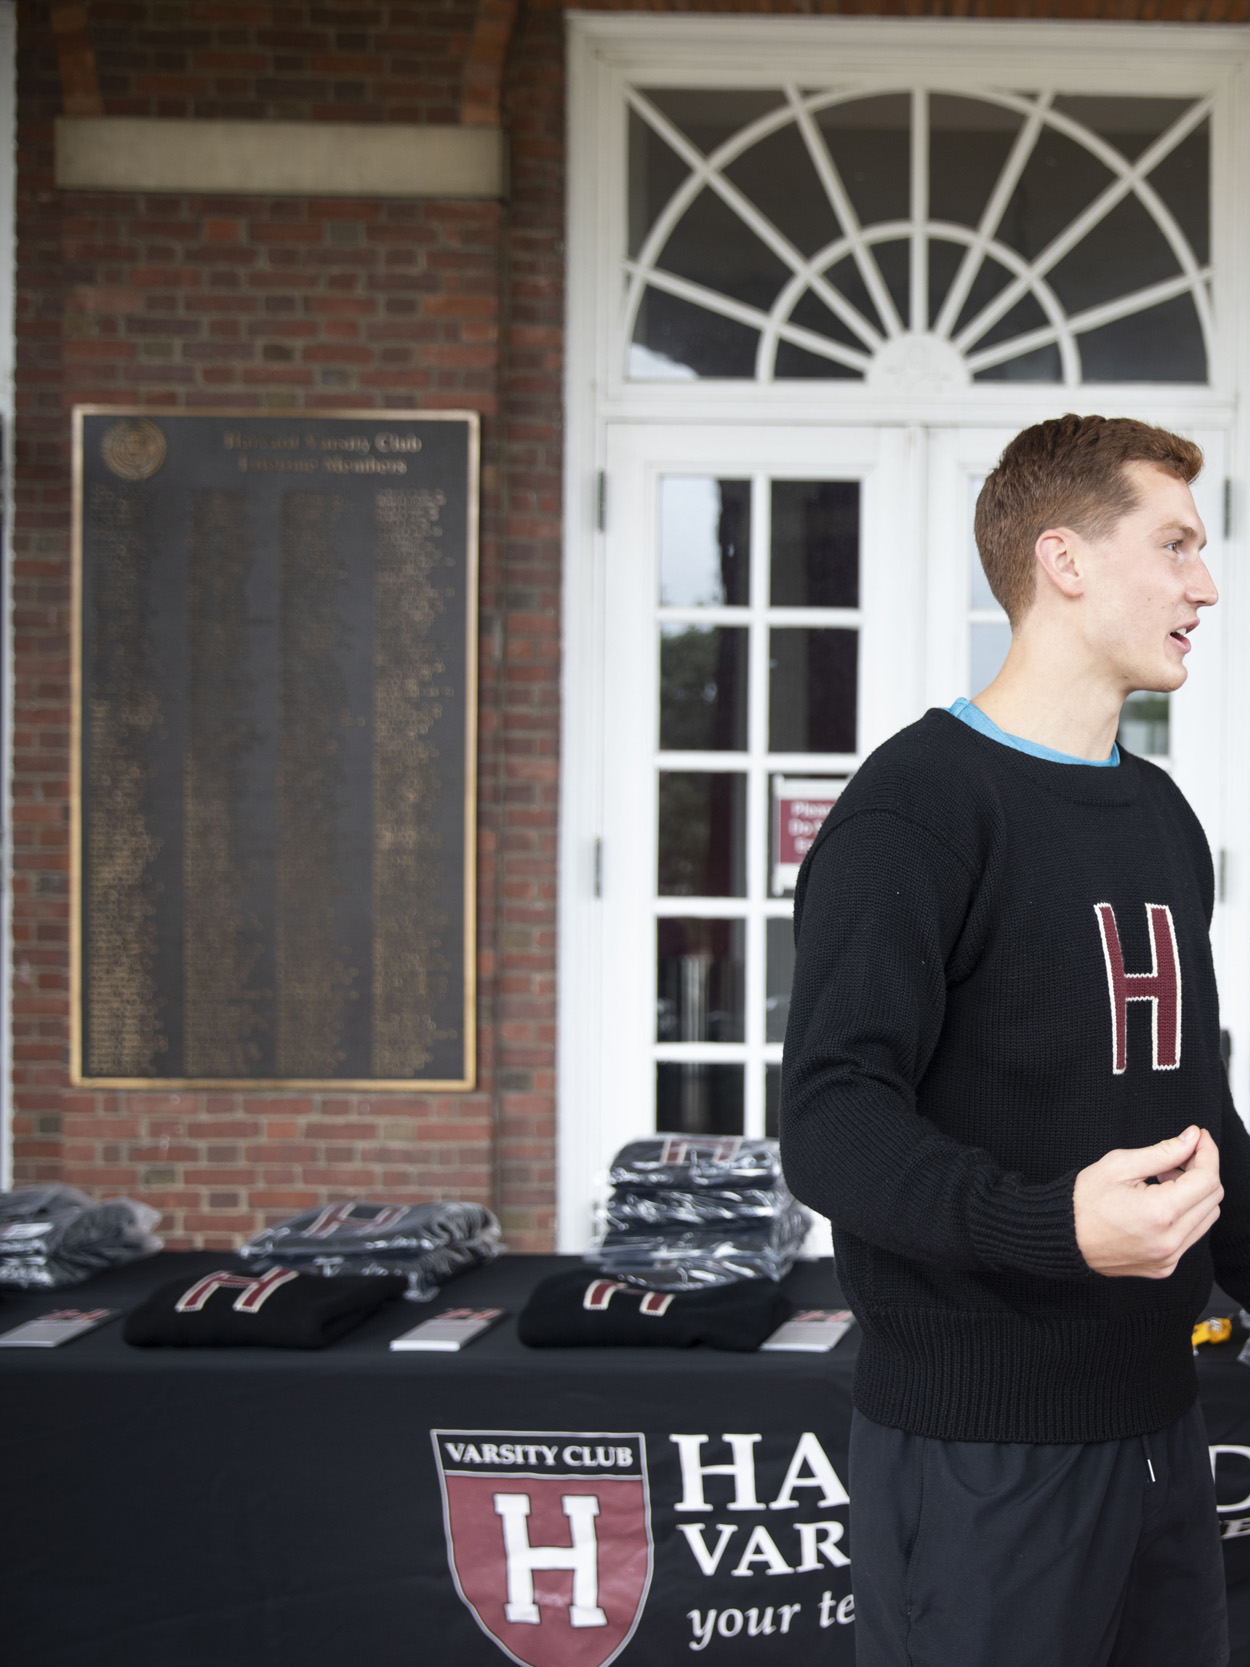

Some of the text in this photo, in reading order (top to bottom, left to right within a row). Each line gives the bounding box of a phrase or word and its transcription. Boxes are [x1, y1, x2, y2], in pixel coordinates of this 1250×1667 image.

[374, 431, 423, 453] Club
[1093, 902, 1182, 1075] H
[444, 1442, 634, 1467] VARSITY CLUB
[493, 1493, 608, 1628] H
[686, 1603, 802, 1652] your
